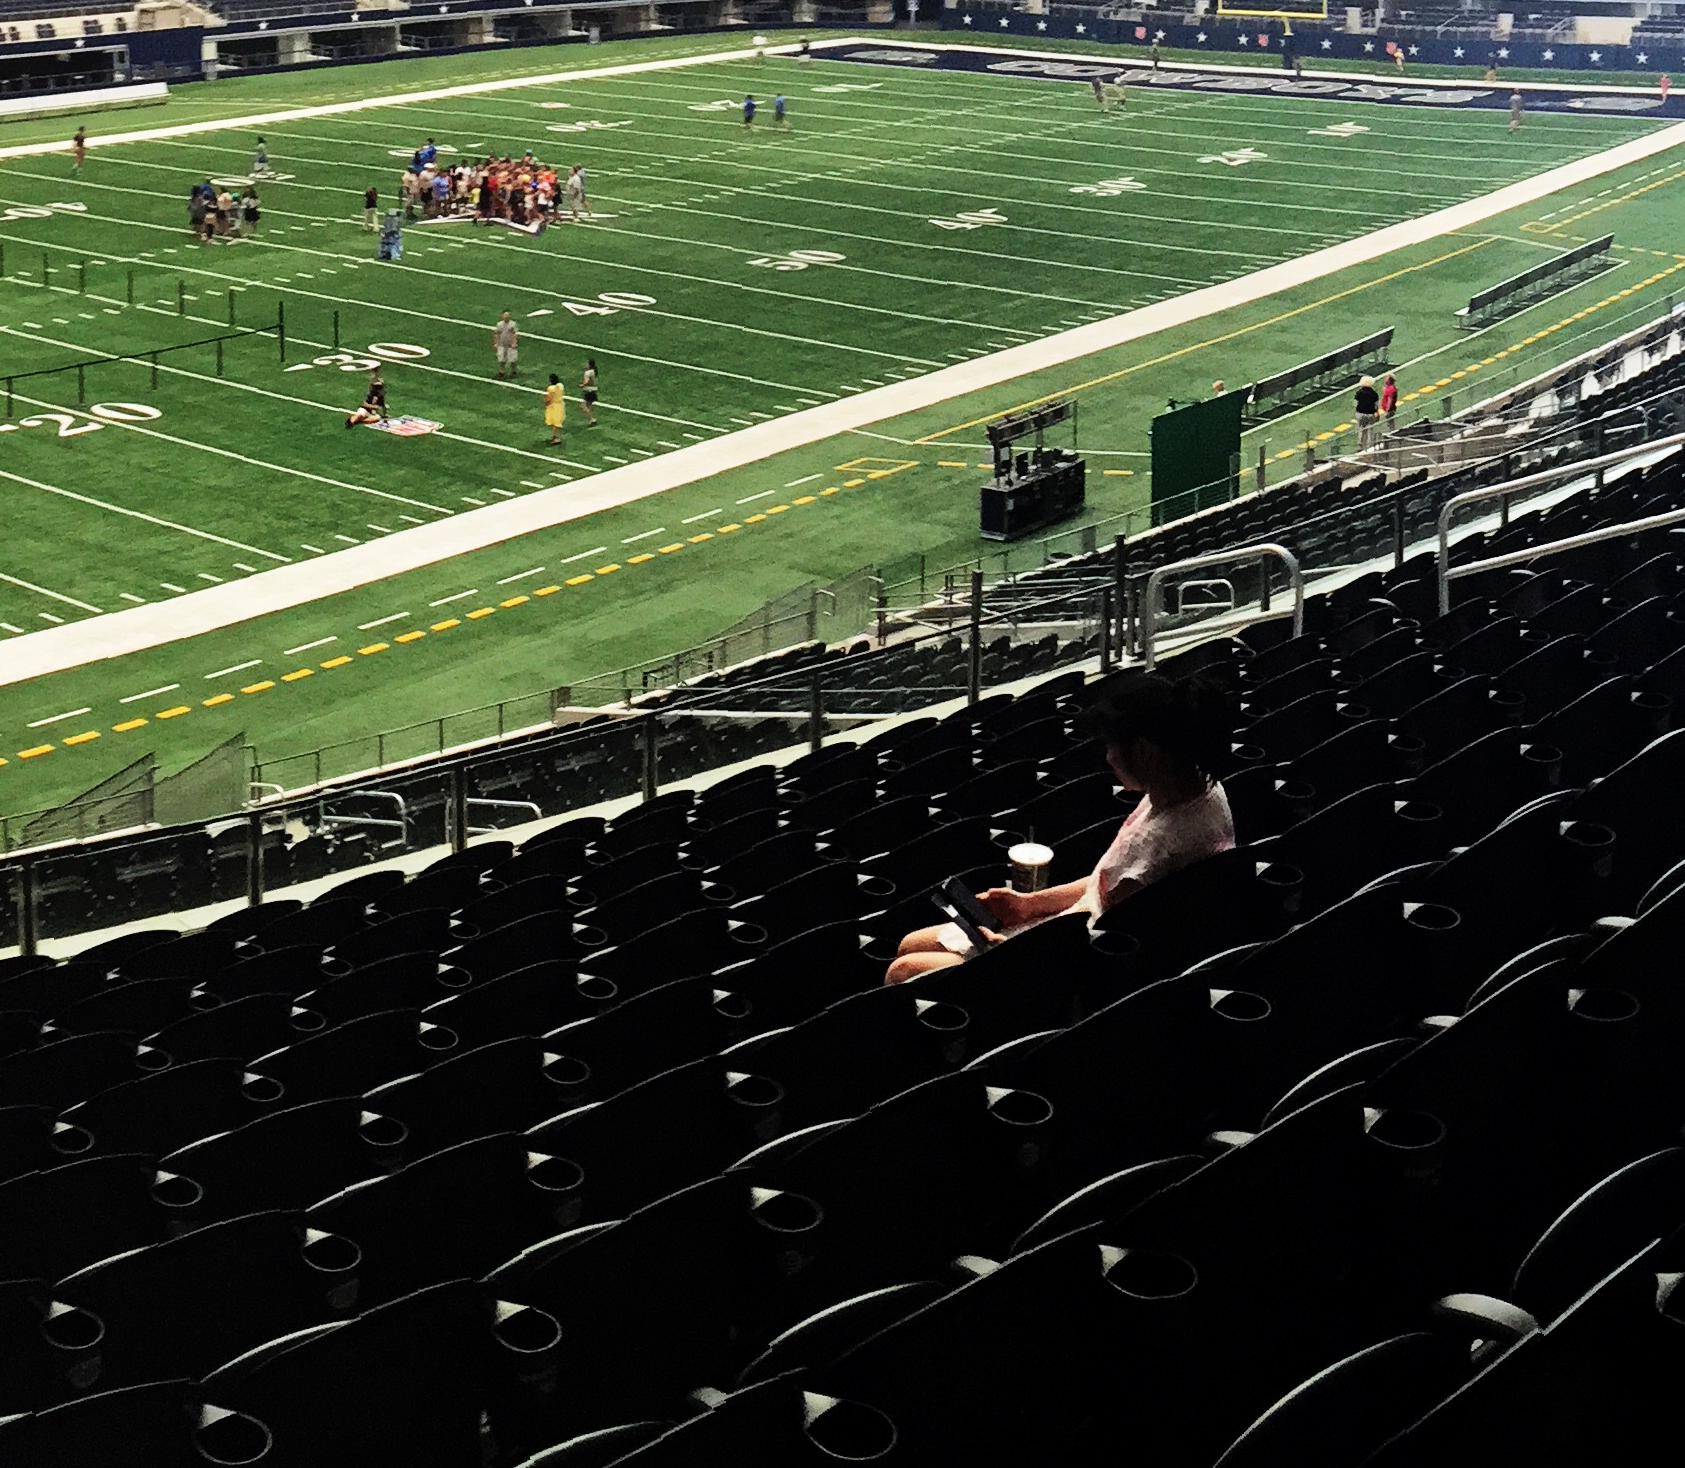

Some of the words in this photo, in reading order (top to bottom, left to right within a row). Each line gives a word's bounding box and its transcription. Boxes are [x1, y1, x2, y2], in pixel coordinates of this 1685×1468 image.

[987, 60, 1495, 105] COWBOYS
[746, 249, 847, 271] 50
[561, 291, 657, 318] 40
[312, 341, 431, 373] 30
[18, 401, 163, 438] 20
